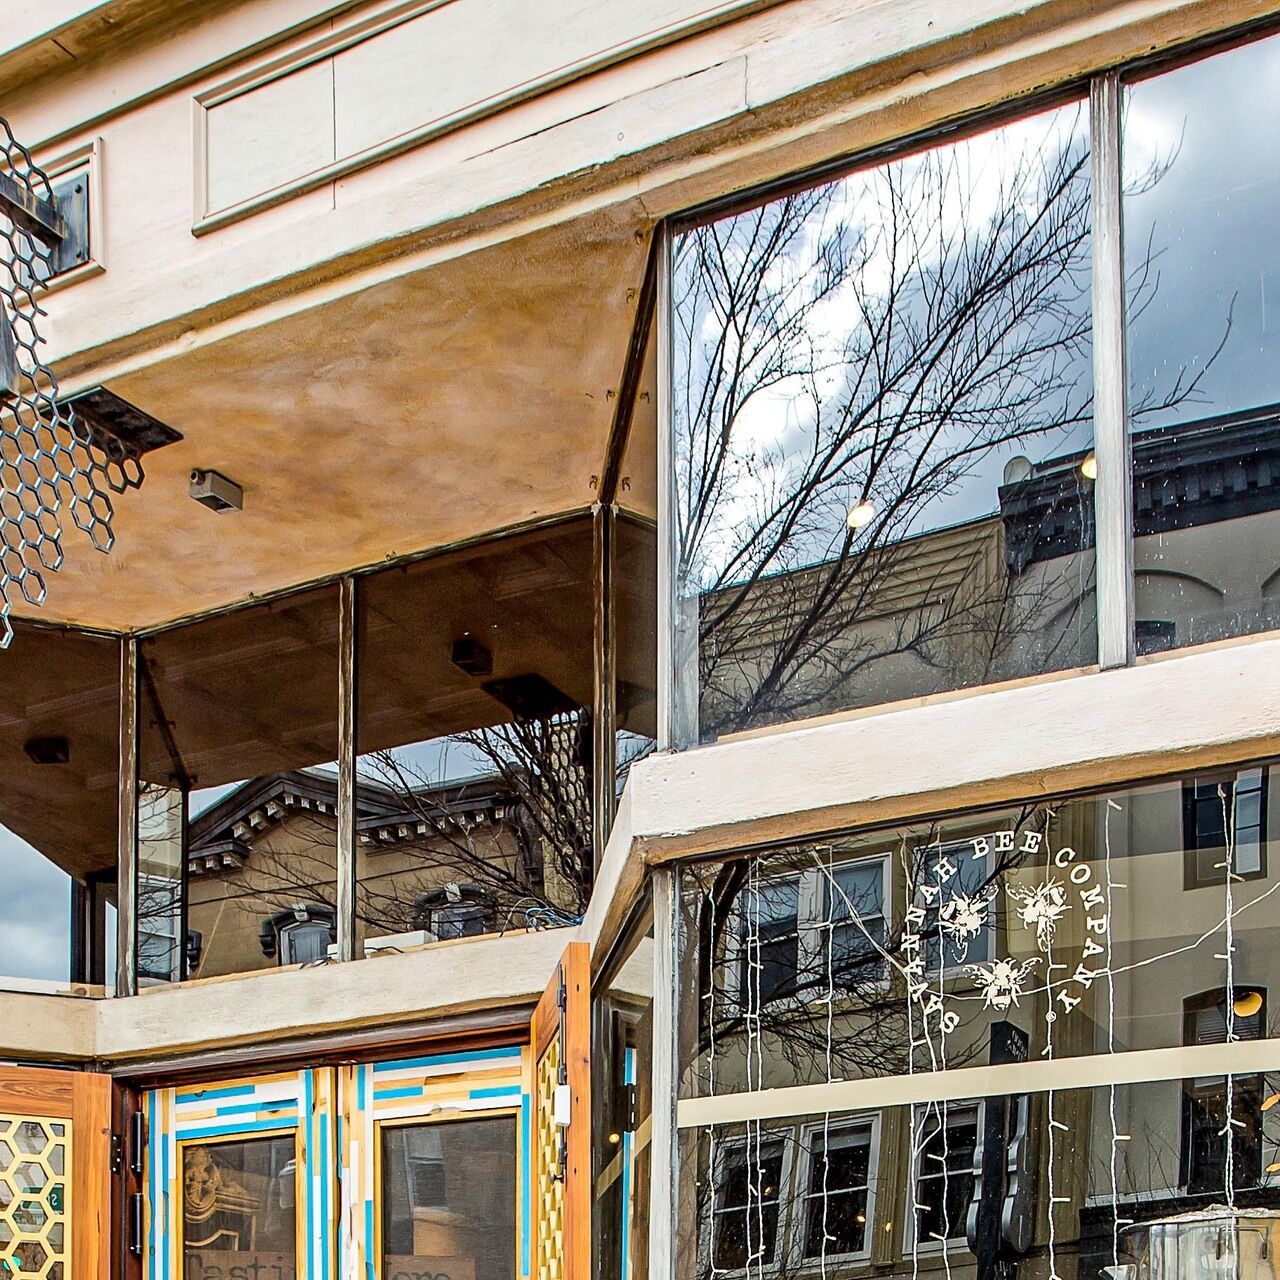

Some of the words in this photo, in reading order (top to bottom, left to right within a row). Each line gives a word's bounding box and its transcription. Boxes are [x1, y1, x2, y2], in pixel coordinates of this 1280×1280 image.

[900, 857, 960, 1034] SAVANNAH
[969, 830, 1043, 860] BEE
[1055, 847, 1108, 1015] COMPANY
